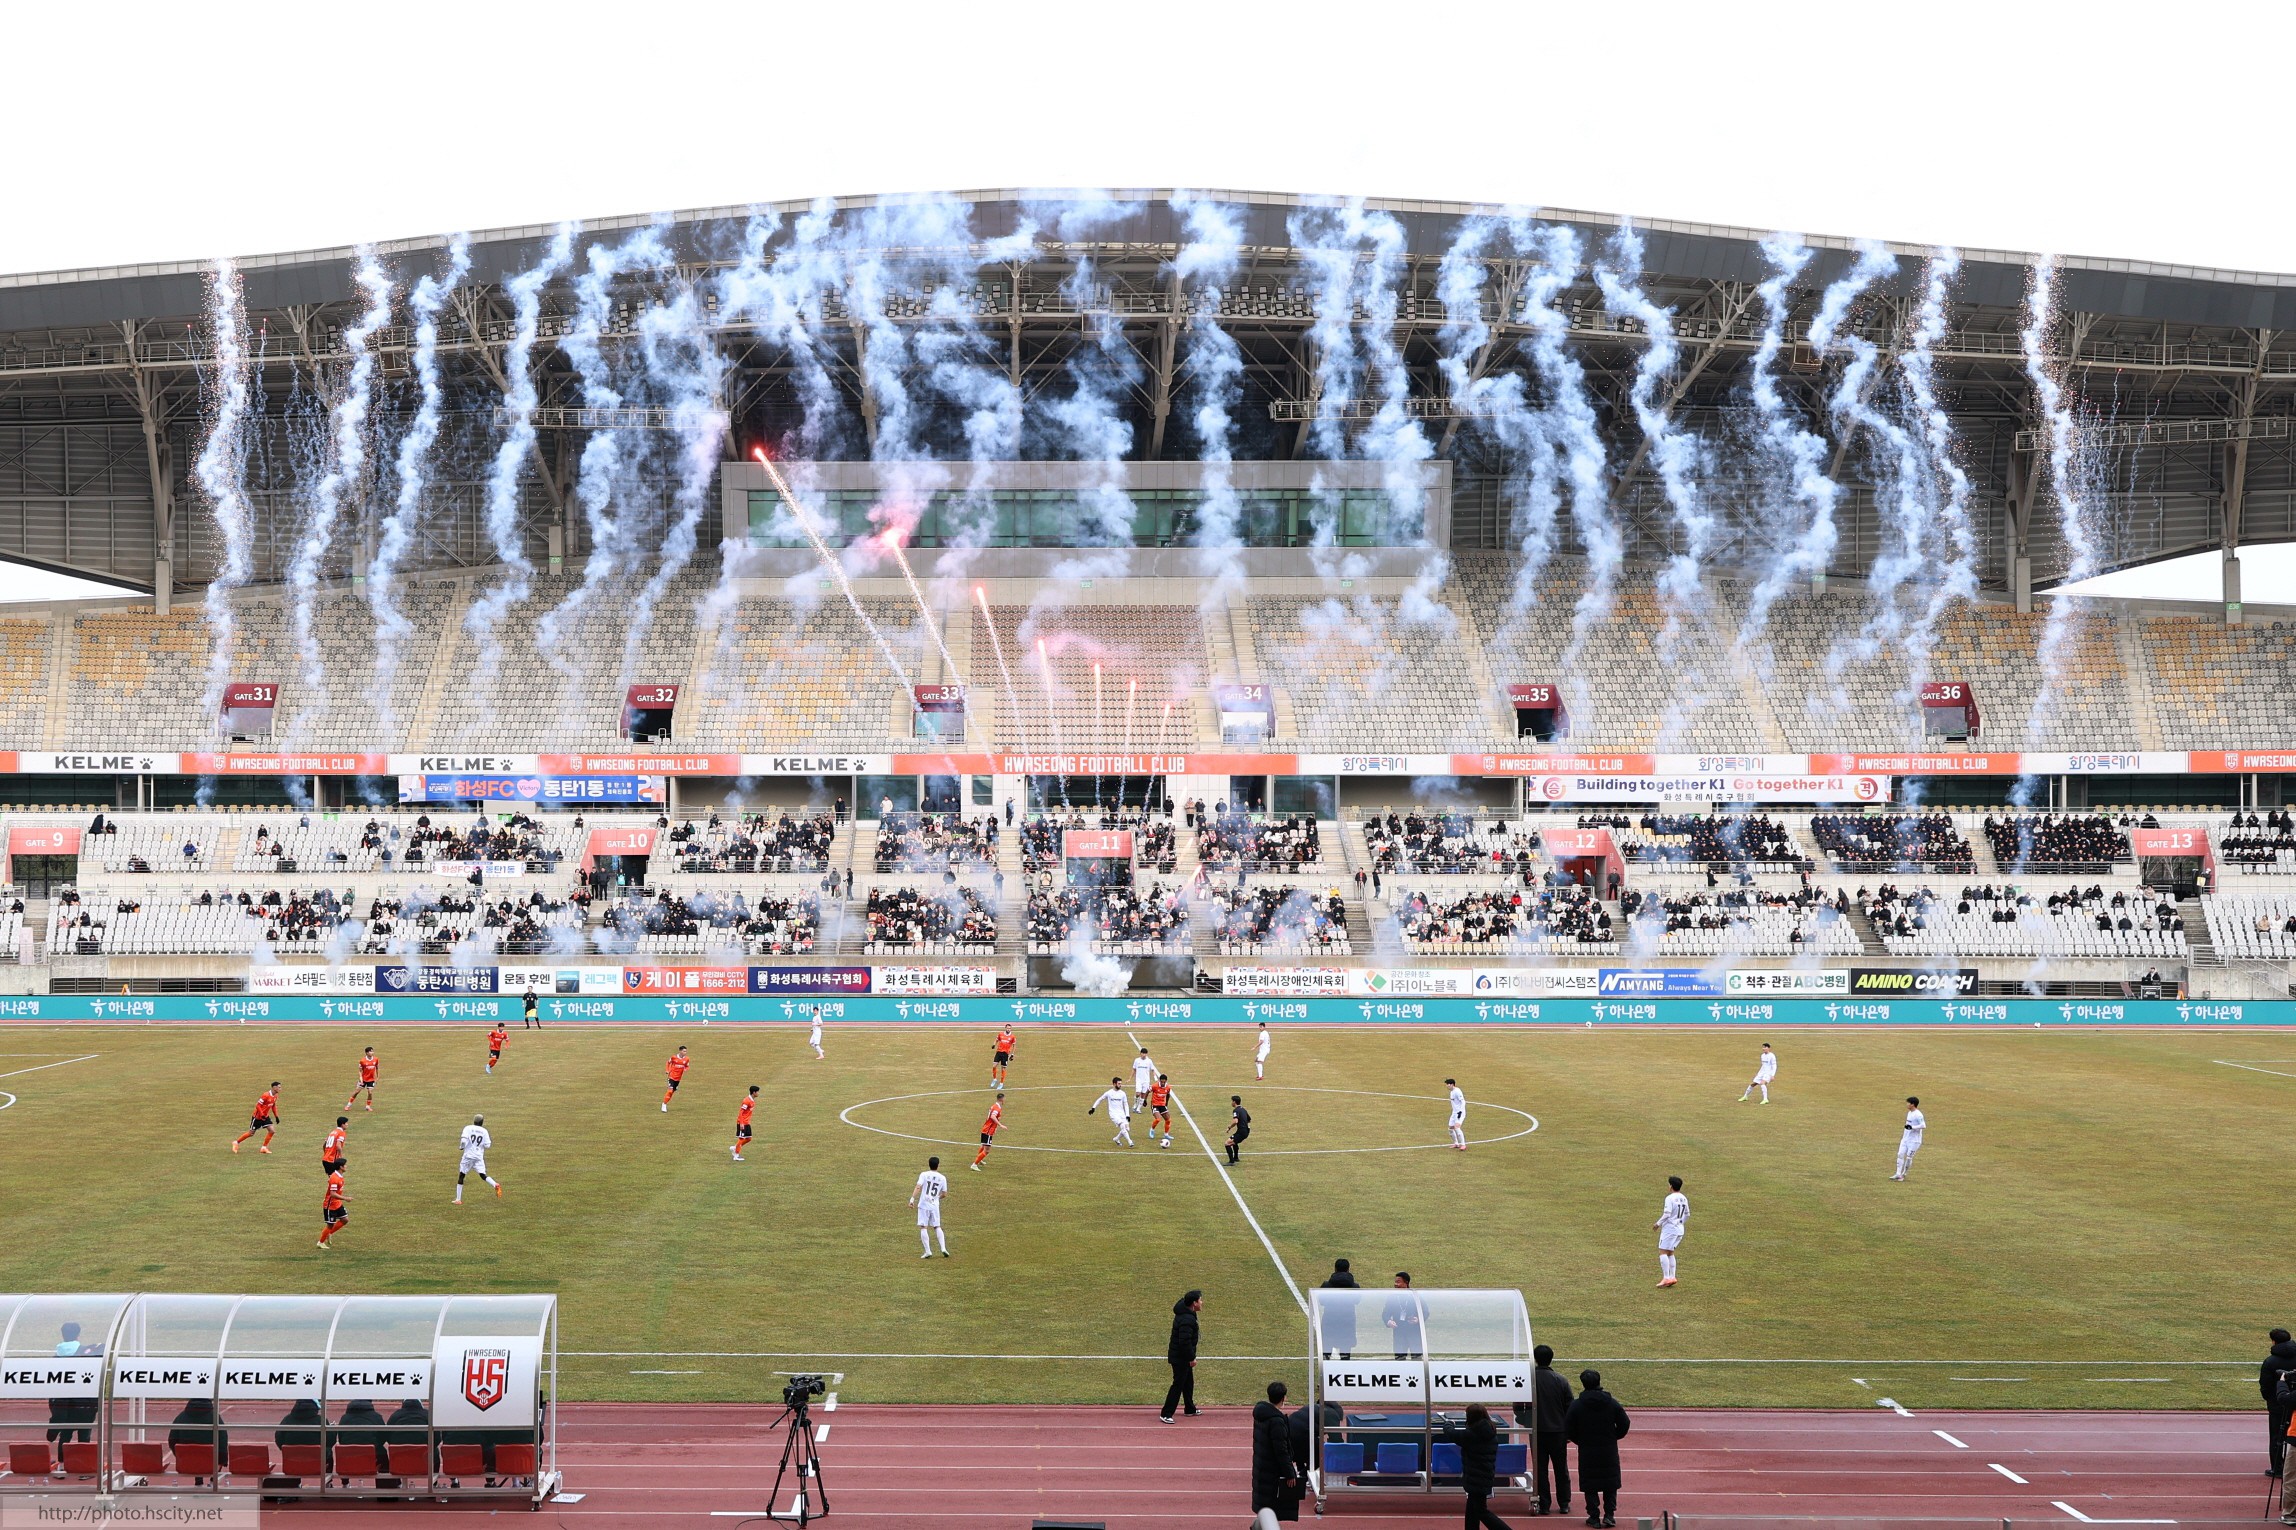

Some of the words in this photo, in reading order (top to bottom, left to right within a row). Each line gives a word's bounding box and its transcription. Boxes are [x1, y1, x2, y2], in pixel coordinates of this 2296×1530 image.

[253, 687, 273, 701] 31
[655, 688, 674, 702] 32
[940, 687, 959, 700] 33
[1243, 686, 1262, 700] 34
[1511, 694, 1530, 702] GATE
[1530, 687, 1550, 702] 35
[1921, 692, 1941, 700] GATE
[1941, 685, 1961, 700] 36
[55, 756, 134, 769] KELME
[230, 758, 280, 770] HWASEONG
[283, 758, 328, 770] FOOTBALL
[331, 758, 355, 770] CLUB
[420, 757, 495, 771] KELME
[586, 759, 635, 771] HWASEONG
[638, 759, 682, 771] FOOTBALL
[685, 759, 709, 771] CLUB
[774, 758, 848, 771] KELME
[1004, 757, 1077, 773] HWASEONG
[1080, 757, 1149, 773] FOOTBALL
[1152, 757, 1186, 773] CLUB
[1342, 757, 1407, 772] 화성특례시
[1500, 759, 1548, 771] HWASEONG
[1551, 759, 1596, 771] FOOTBALL
[1599, 759, 1623, 771] CLUB
[1699, 757, 1764, 772] 화성특례시
[1858, 758, 1908, 770] HWASEONG
[1911, 758, 1959, 770] FOOTBALL
[1962, 758, 1988, 770] CLUB
[2069, 754, 2140, 770] 화성특례시
[454, 780, 515, 797] 화성FC
[519, 784, 540, 792] Victory
[544, 780, 604, 797] 동탄1동
[1576, 778, 1637, 791] Building
[1640, 778, 1706, 791] together
[1709, 778, 1725, 790] K1
[1733, 778, 1754, 790] Go
[1757, 778, 1824, 791] together
[1827, 778, 1844, 790] K1
[25, 839, 47, 847] GATE
[52, 832, 64, 847] 9
[606, 840, 626, 848] GATE
[627, 833, 648, 848] 10
[1080, 842, 1099, 850] GATE
[1100, 835, 1120, 850] 11
[1554, 840, 1574, 848] GATE
[1576, 833, 1596, 849] 12
[2146, 840, 2169, 848] GATE
[2170, 833, 2193, 849] 13
[252, 978, 292, 987] MARKET
[294, 972, 327, 987] 스타필드
[348, 972, 373, 987] 동탄점
[417, 975, 491, 990] 동탄시티병원
[504, 973, 526, 985] 운동
[529, 973, 551, 985] 후엔
[585, 973, 617, 985] 레그팩
[702, 979, 745, 988] 1666-2112
[770, 973, 862, 985] 화성특례시축구협회
[885, 974, 983, 986] 화성특례시체육회
[1226, 974, 1344, 987] 화성특례시장애인체육회
[1855, 974, 1913, 989] AMINO
[1914, 975, 1974, 990] COACH
[1668, 984, 1691, 992] Always
[108, 1001, 153, 1015] 하나은행
[223, 1001, 268, 1015] 하나은행
[338, 1001, 383, 1016] 하나은행
[453, 1001, 498, 1016] 하나은행
[568, 1002, 613, 1016] 하나은행
[683, 1002, 728, 1017] 하나은행
[798, 1002, 843, 1017] 하나은행
[914, 1002, 959, 1017] 하나은행
[1030, 1002, 1075, 1017] 하나은행
[1145, 1003, 1190, 1018] 하나은행
[1261, 1003, 1306, 1018] 하나은행
[1377, 1003, 1423, 1018] 하나은행
[1494, 1003, 1539, 1018] 하나은행
[1610, 1004, 1655, 1019] 하나은행
[1726, 1004, 1772, 1019] 하나은행
[1843, 1004, 1889, 1019] 하나은행
[1960, 1004, 2006, 1019] 하나은행
[2077, 1005, 2123, 1020] 하나은행
[2195, 1005, 2242, 1020] 하나은행
[470, 1134, 483, 1147] 99
[926, 1181, 939, 1196] 15
[1677, 1204, 1685, 1218] 17
[469, 1349, 506, 1357] HWASEONG
[4, 1371, 76, 1383] KELME
[119, 1371, 191, 1383] KELME
[226, 1372, 297, 1385] KELME
[333, 1373, 405, 1385] KELME
[1328, 1374, 1400, 1387] KELME
[1435, 1375, 1507, 1388] KELME
